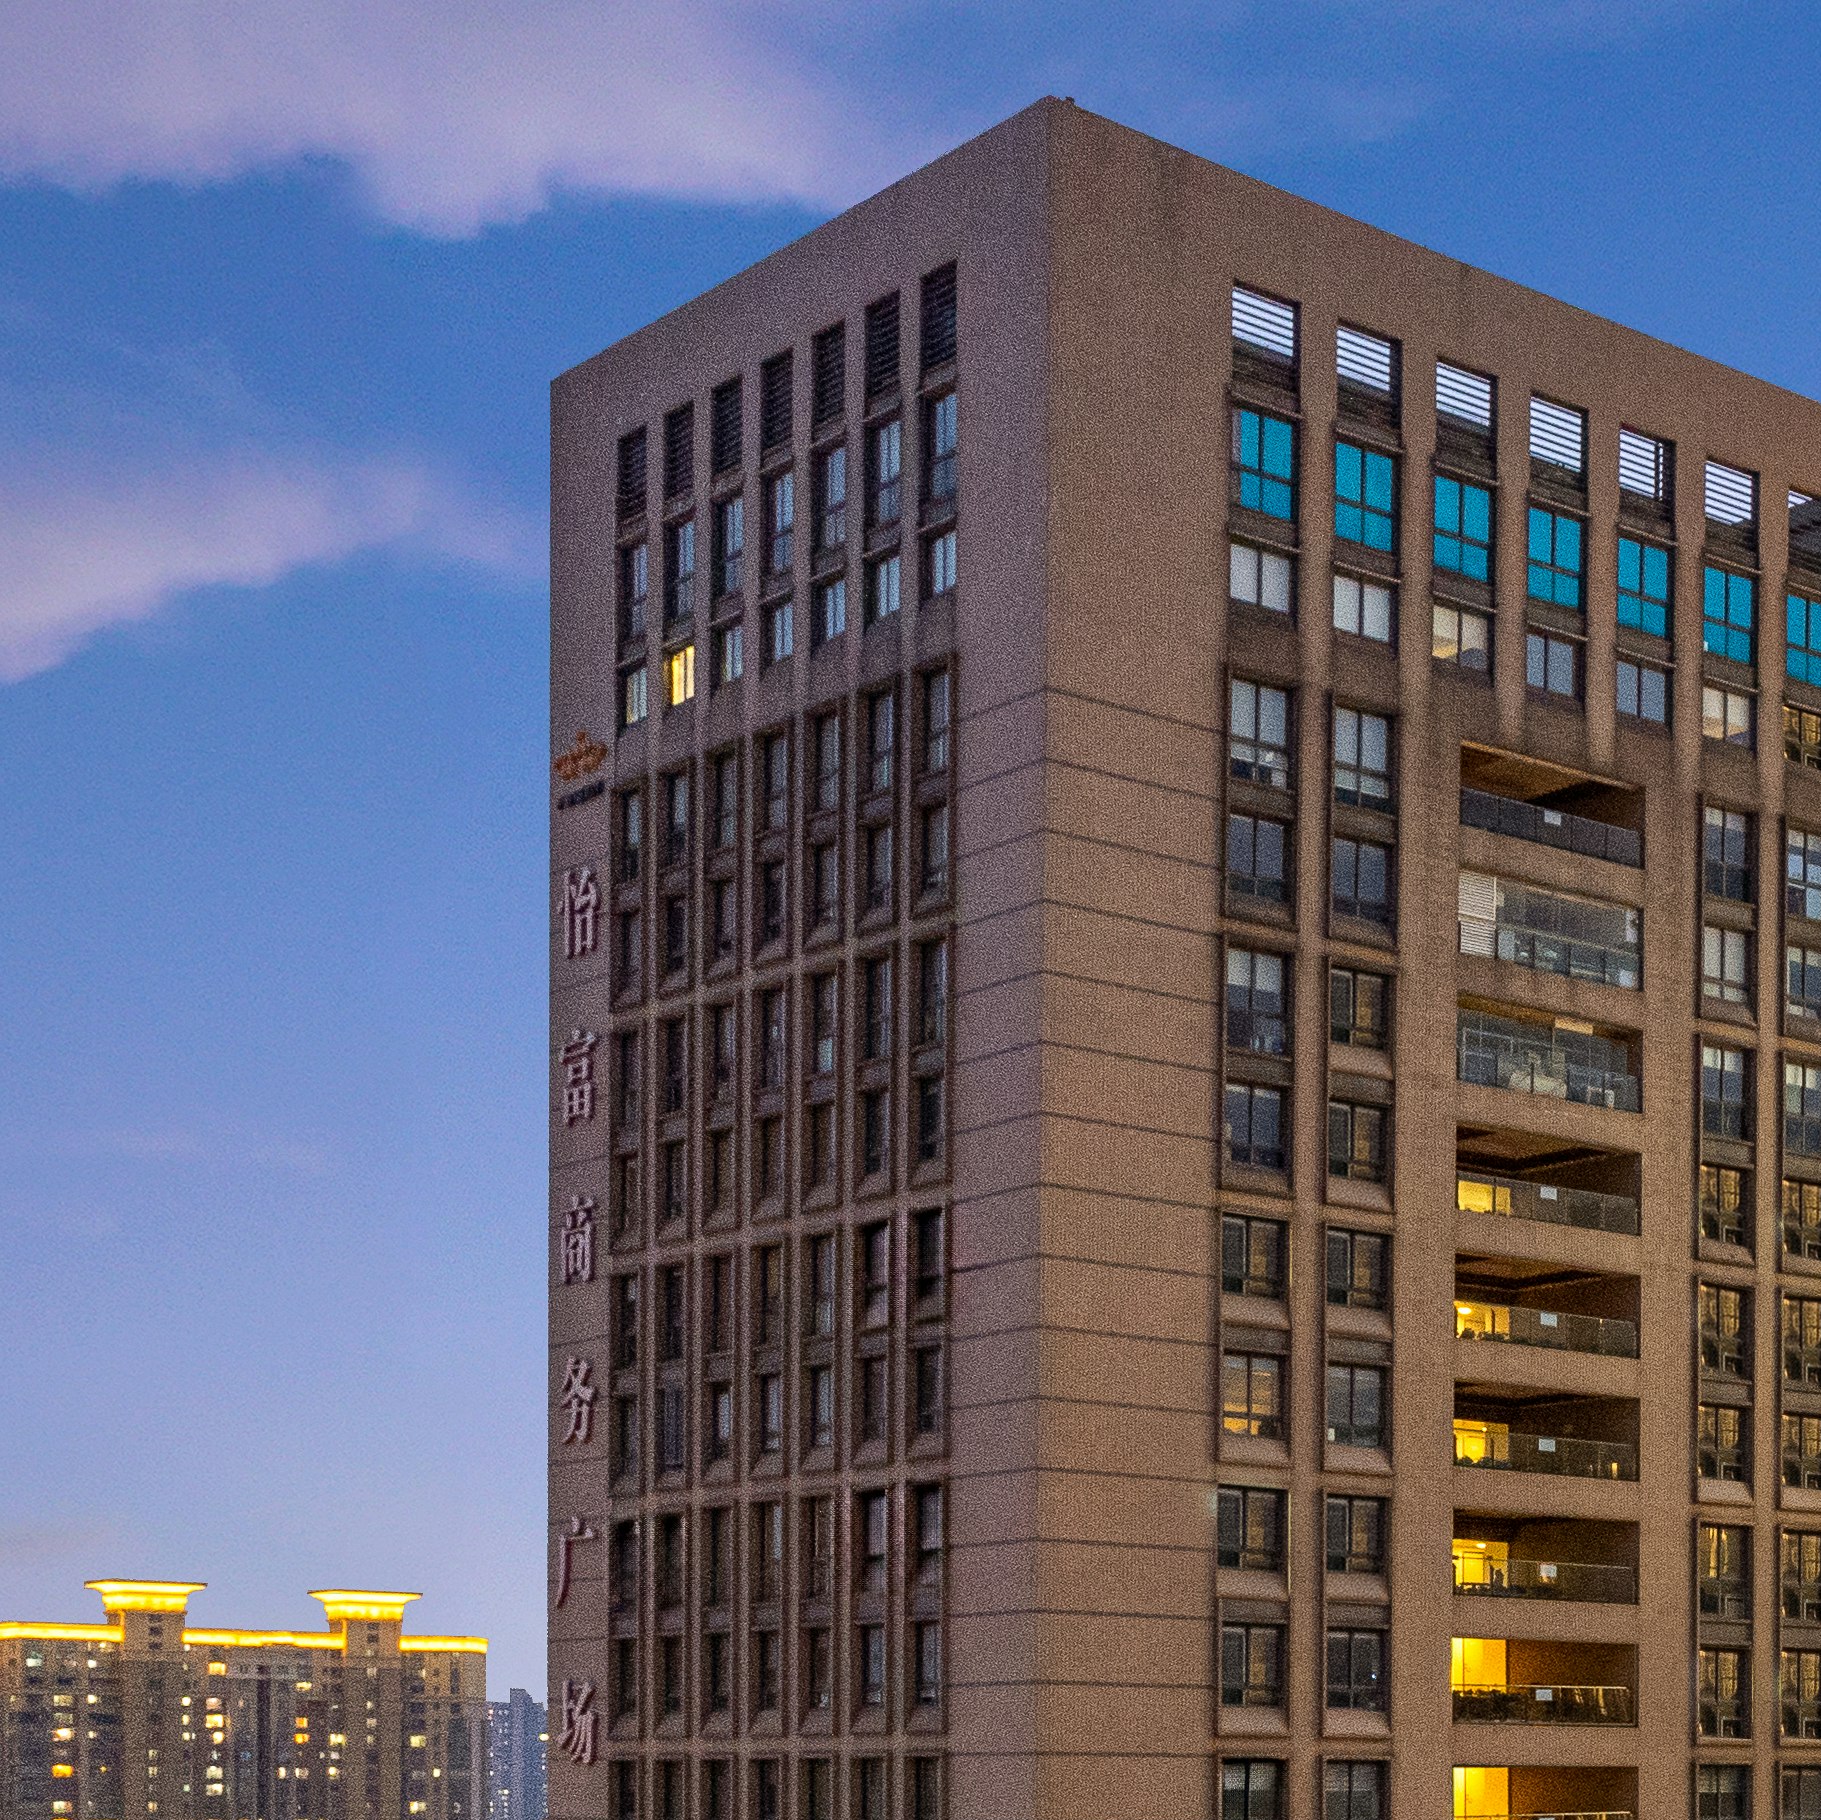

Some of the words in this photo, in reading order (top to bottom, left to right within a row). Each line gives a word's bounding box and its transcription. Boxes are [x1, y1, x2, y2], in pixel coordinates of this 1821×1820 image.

[556, 867, 600, 1765] 怡富商务广场
